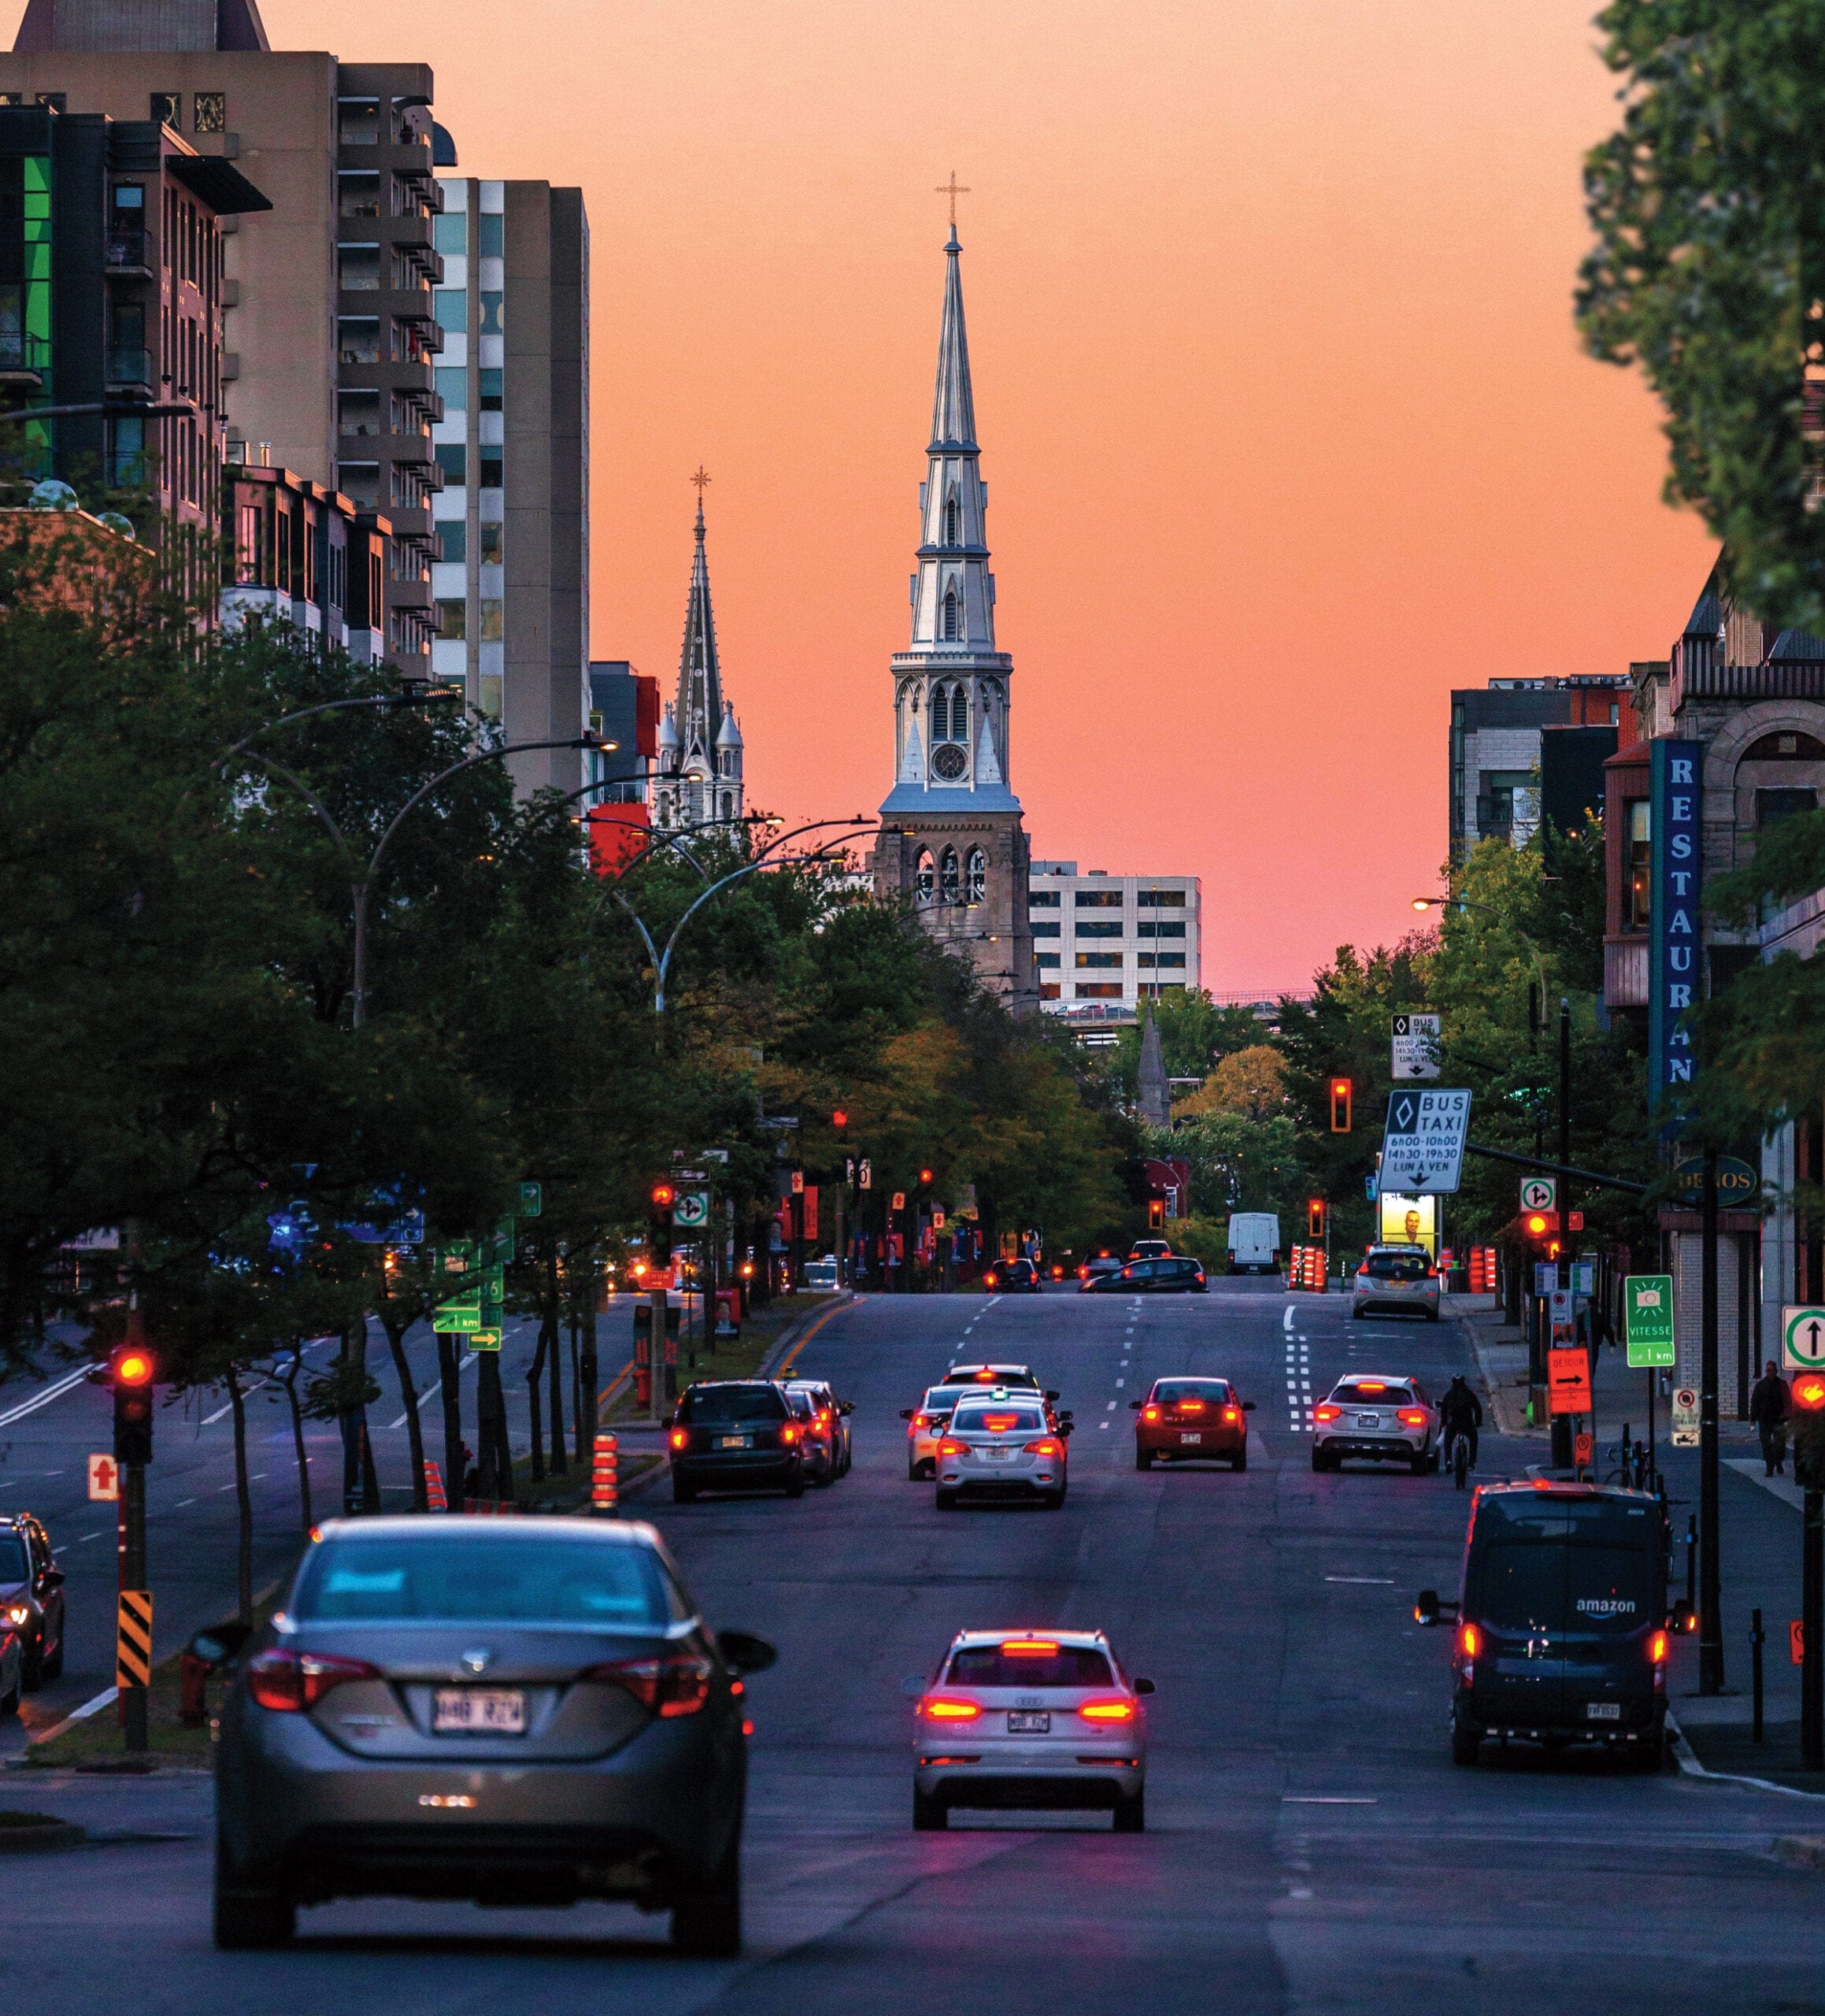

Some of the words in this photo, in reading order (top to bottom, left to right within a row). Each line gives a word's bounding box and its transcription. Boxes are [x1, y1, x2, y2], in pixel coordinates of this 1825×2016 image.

[1669, 758, 1694, 1120] RESTAURAN
[1413, 1018, 1433, 1027] BUS
[1422, 1097, 1463, 1111] BUS
[1421, 1117, 1461, 1131] TAXI
[1391, 1136, 1457, 1147] 6h00-10h00
[1388, 1149, 1457, 1159] 14h30-19h30
[1394, 1162, 1415, 1172] LUN
[1428, 1162, 1449, 1171] VEN
[463, 1319, 477, 1328] km
[1630, 1326, 1671, 1336] VITESSE
[1657, 1352, 1671, 1361] km
[1576, 1598, 1635, 1614] amazon
